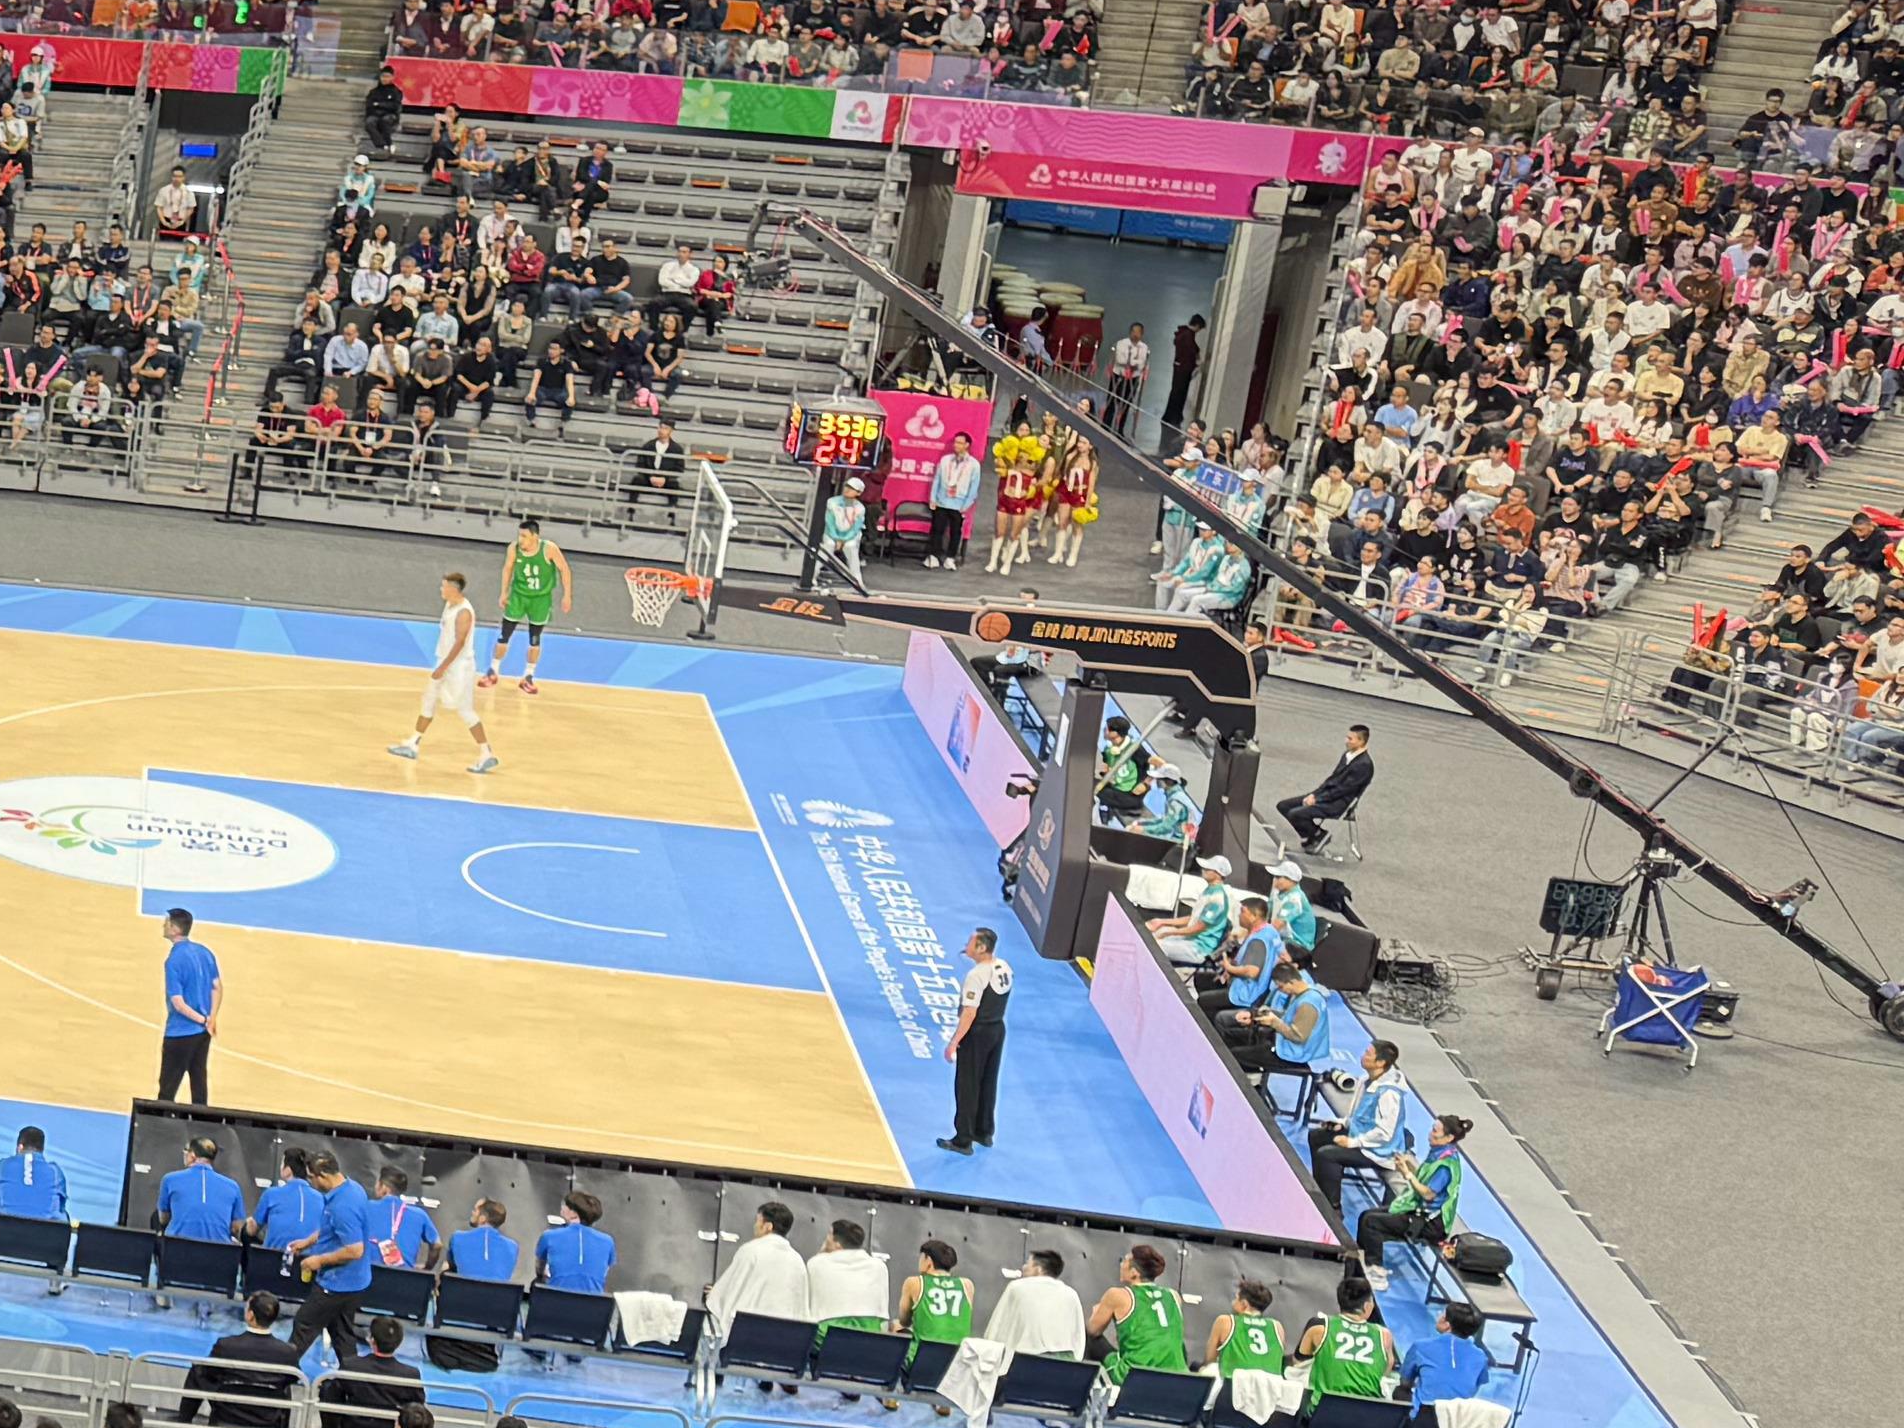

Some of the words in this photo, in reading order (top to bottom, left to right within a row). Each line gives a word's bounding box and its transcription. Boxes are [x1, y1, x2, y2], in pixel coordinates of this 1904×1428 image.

[814, 434, 859, 466] 24
[127, 823, 288, 850] Dongguan
[928, 1287, 963, 1317] 37
[1151, 1301, 1169, 1328] 1
[1247, 1328, 1269, 1355] 3
[1334, 1332, 1375, 1365] 22
